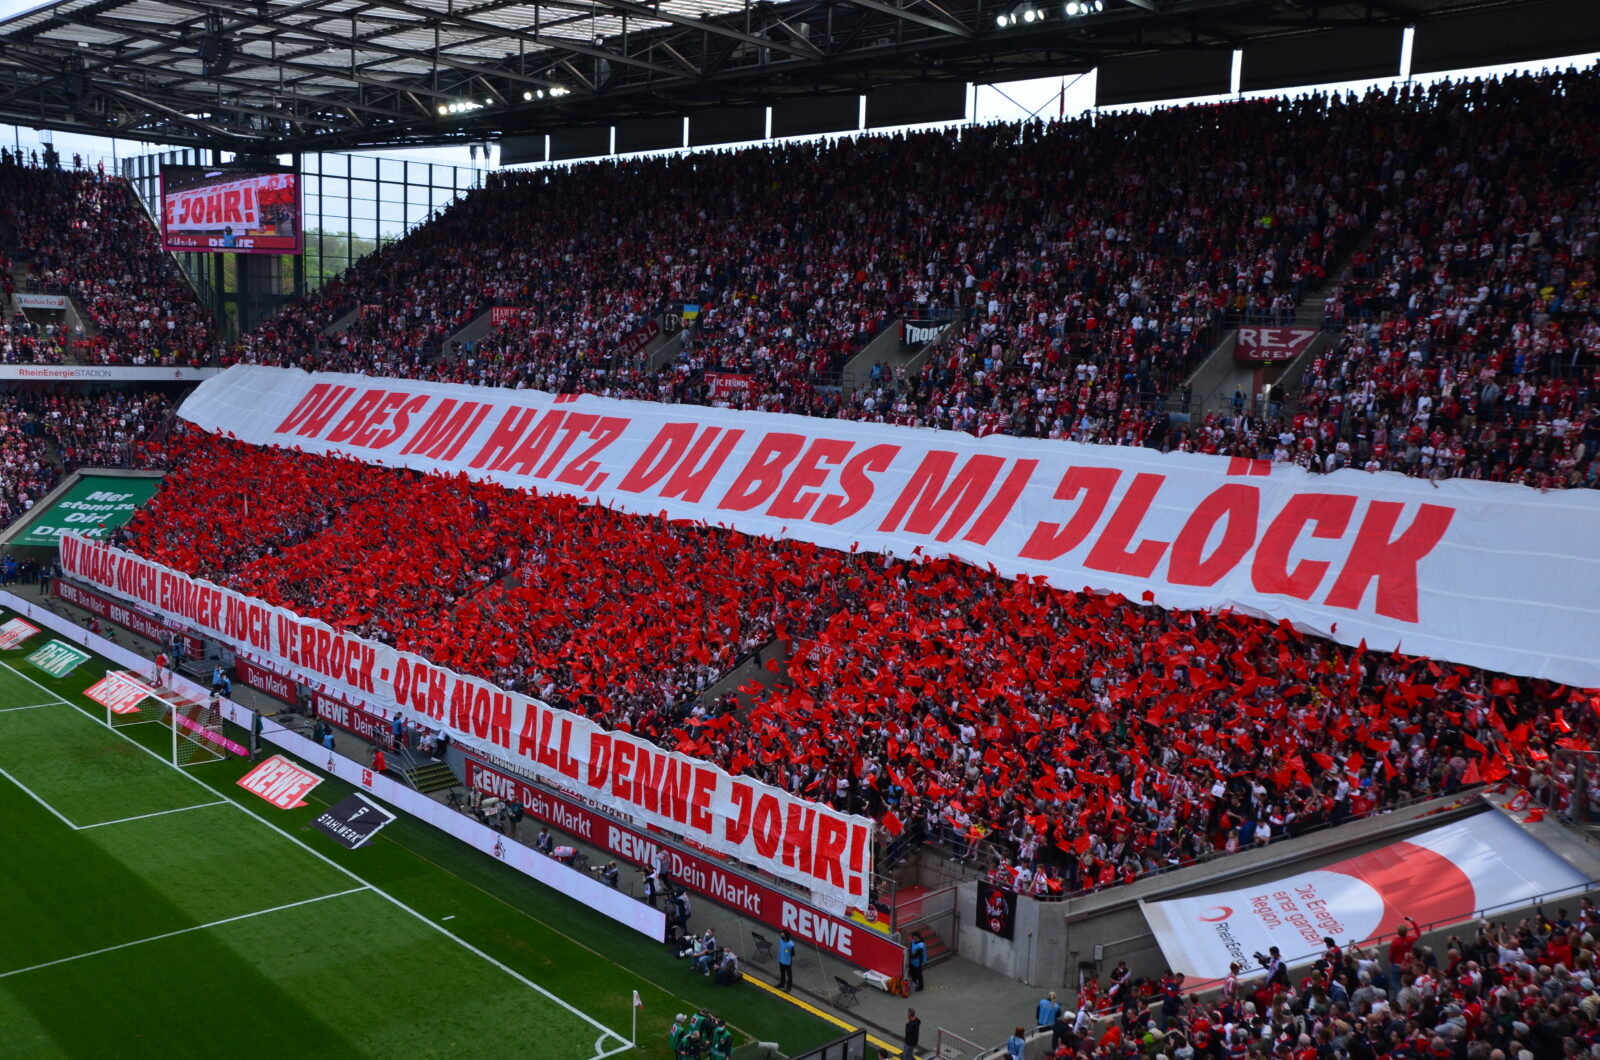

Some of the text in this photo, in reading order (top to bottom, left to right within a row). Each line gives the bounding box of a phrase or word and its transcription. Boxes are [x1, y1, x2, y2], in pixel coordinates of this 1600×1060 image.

[179, 187, 255, 225] JOHR!
[19, 368, 111, 377] RheinEnergieSTADION
[59, 501, 111, 511] stonn
[86, 491, 134, 502] Mer
[274, 383, 1456, 624] DU BES MI HÄTZ, DU BES MI JLÖCK
[64, 512, 114, 523] Dir!
[60, 583, 78, 602] REWE
[110, 604, 130, 627] REWE
[132, 613, 145, 632] Dein
[28, 643, 81, 675] DEVK
[248, 668, 289, 698] Dein Markt
[62, 535, 79, 573] DU
[79, 542, 116, 588] MÄÄS
[117, 557, 157, 606] MICH
[160, 572, 222, 632] EMMER
[224, 595, 272, 652] NOCH
[277, 614, 376, 694] VERRÖCK
[393, 657, 447, 721] OCH
[449, 678, 513, 749] NOH
[518, 703, 579, 780] ALL
[587, 732, 717, 835] DENNE
[725, 781, 867, 896] JOHR!
[317, 696, 349, 727] REWE
[353, 712, 374, 737] Dein
[242, 758, 315, 806] REWE
[473, 765, 516, 801] REWE
[523, 787, 549, 823] Dein
[553, 801, 592, 838] Markt
[316, 813, 363, 844] STAHLWERK
[672, 853, 706, 890] Dein
[710, 871, 762, 915] Markt
[782, 900, 853, 956] REWE
[1272, 890, 1325, 947] einer ganzen
[1306, 899, 1345, 935] Energie
